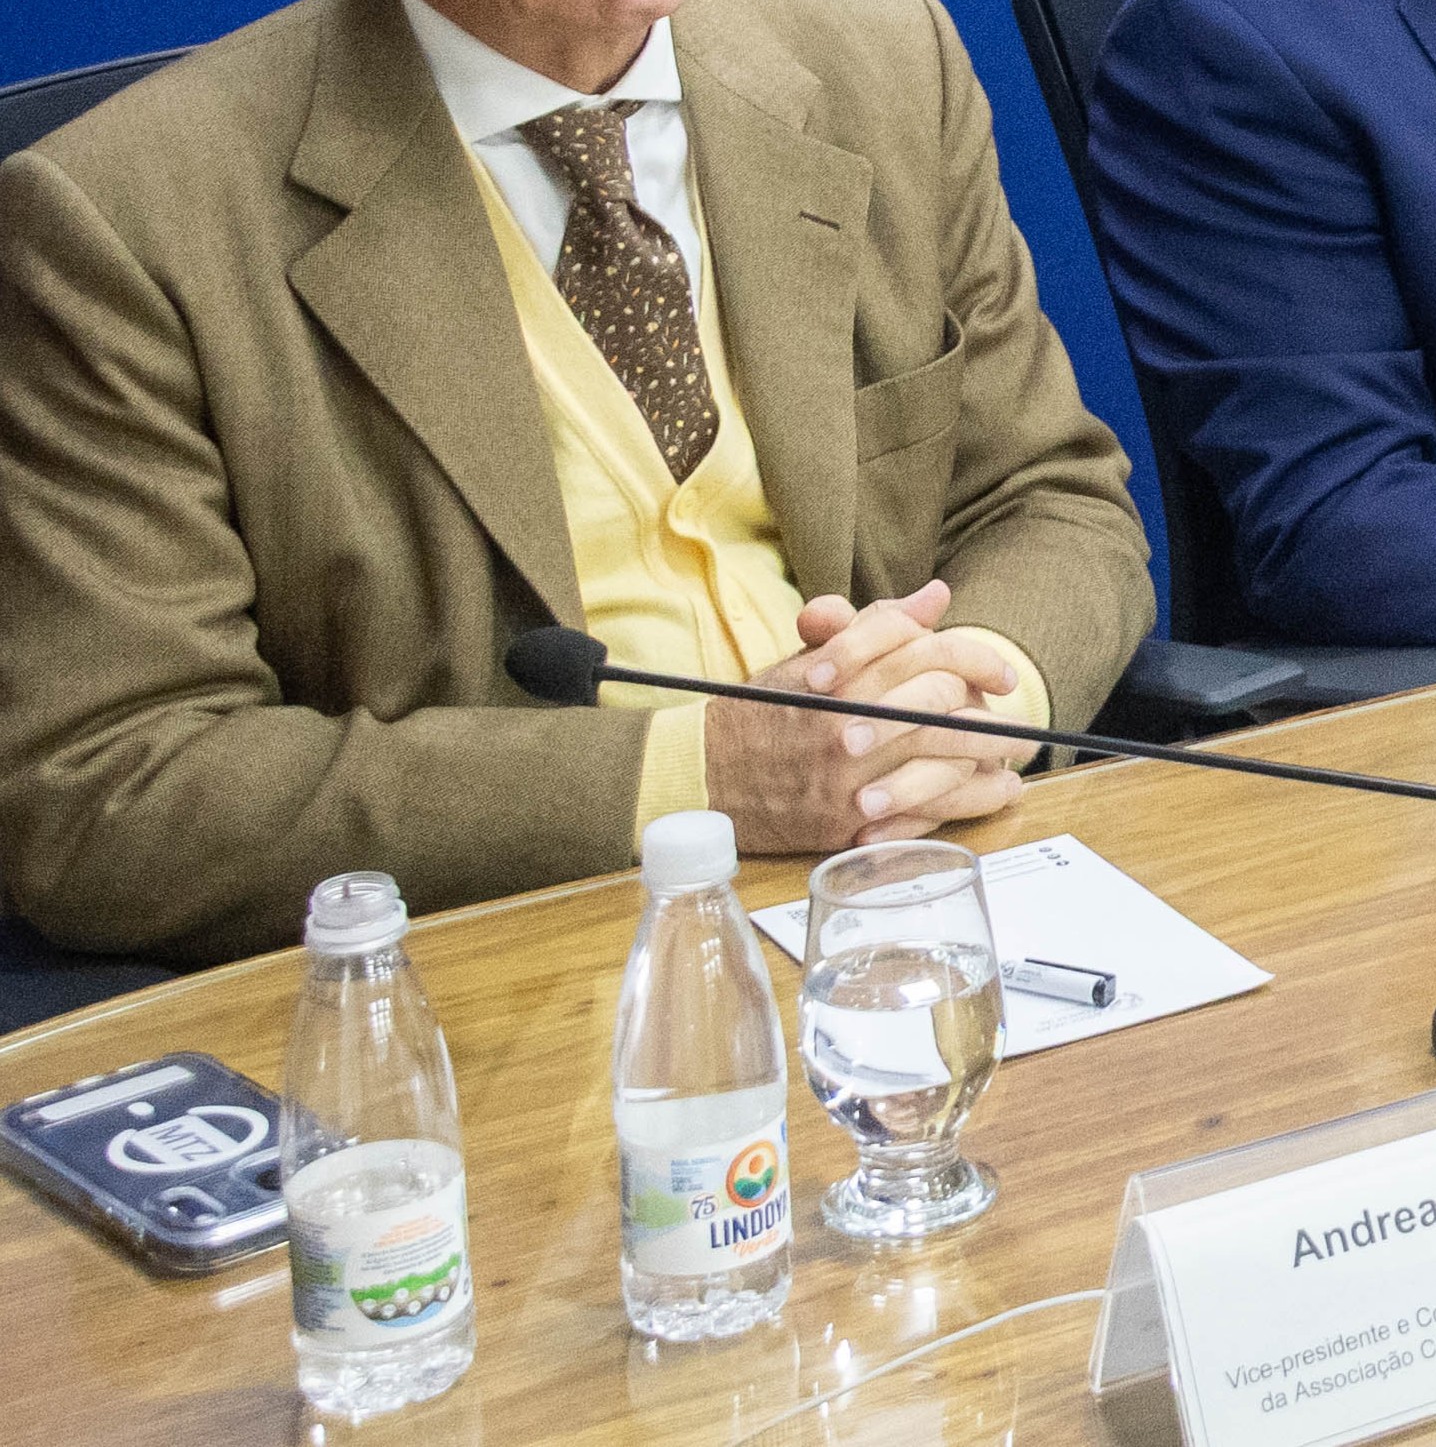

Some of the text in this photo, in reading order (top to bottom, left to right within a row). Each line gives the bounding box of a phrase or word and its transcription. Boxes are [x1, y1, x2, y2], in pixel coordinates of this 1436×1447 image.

[149, 1123, 224, 1162] MTZ
[691, 1194, 717, 1220] 75
[1225, 1323, 1391, 1390] Vice-presidente
[1397, 1317, 1410, 1335] e
[1261, 1391, 1288, 1414] da
[1294, 1349, 1415, 1403] Associação
